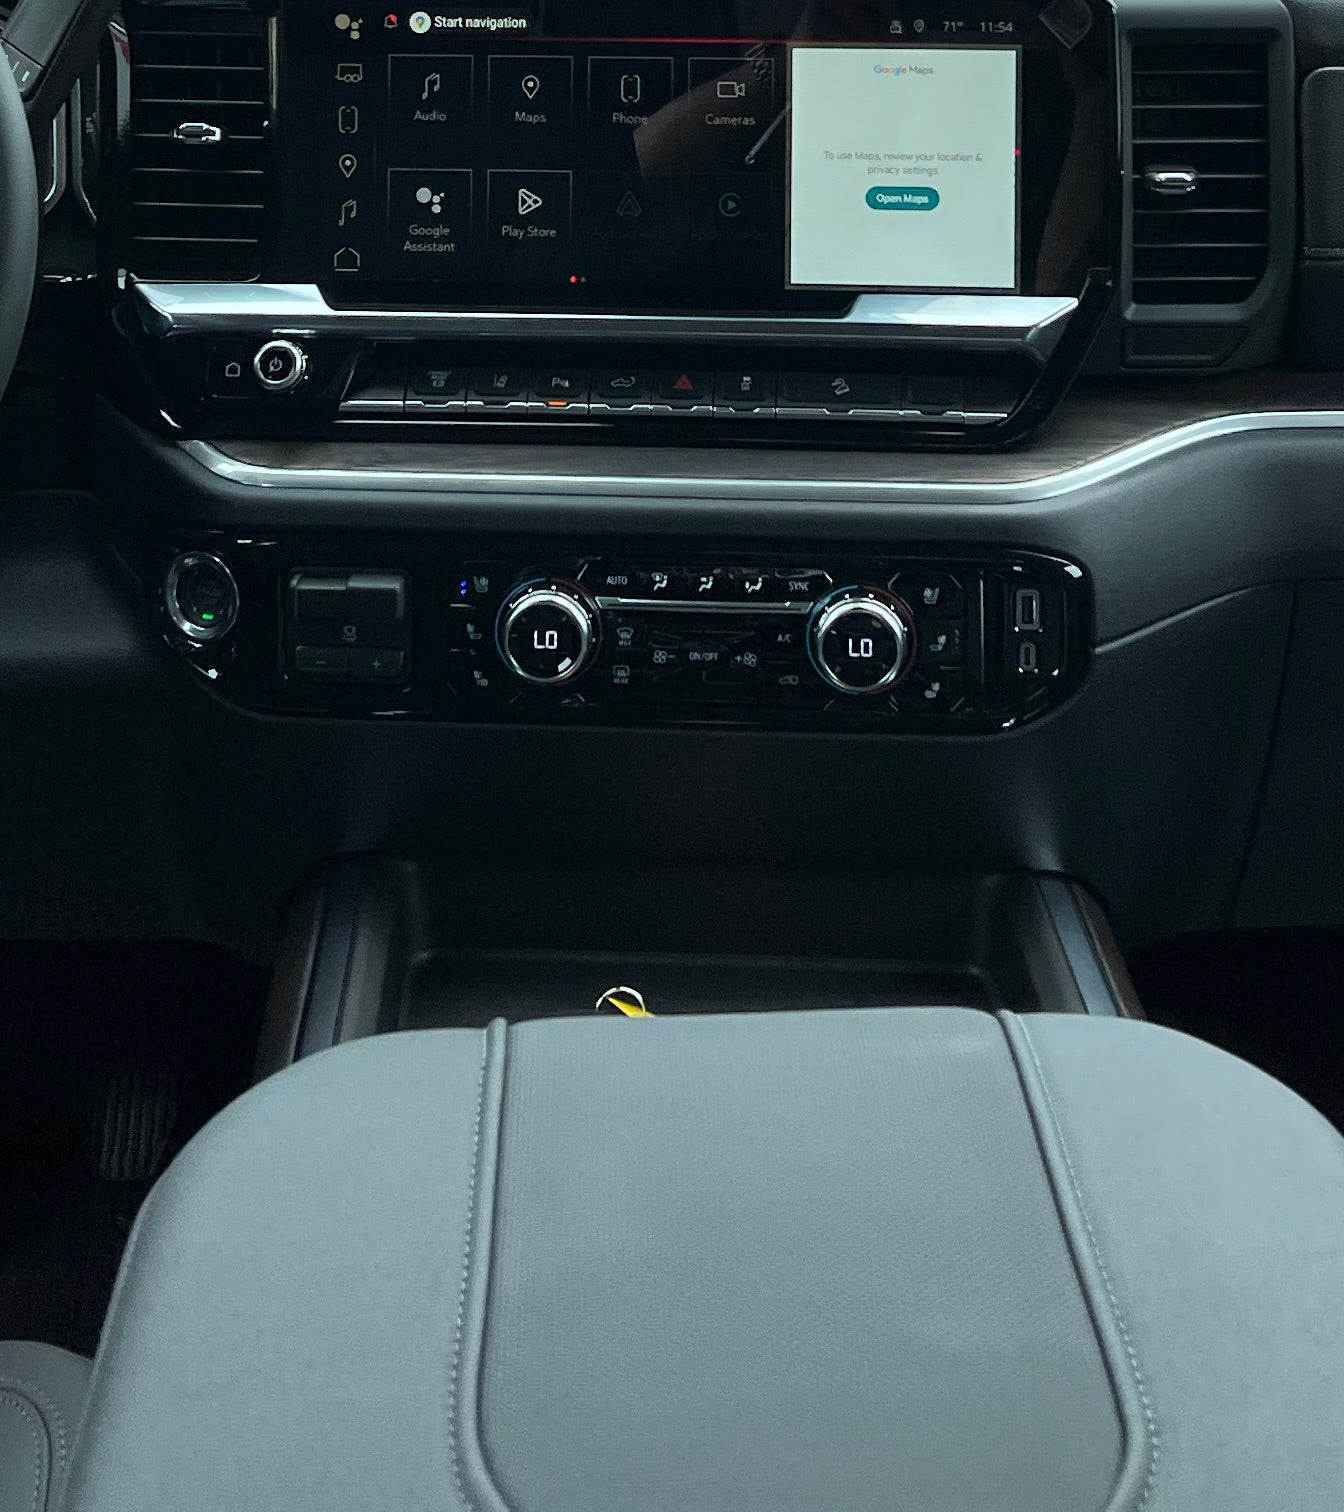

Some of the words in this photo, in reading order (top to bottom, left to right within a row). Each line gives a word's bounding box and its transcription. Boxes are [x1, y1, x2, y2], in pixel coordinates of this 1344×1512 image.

[434, 15, 463, 29] Start
[465, 15, 528, 32] navigation
[979, 21, 1014, 33] 11:54
[874, 64, 907, 76] Google
[909, 65, 934, 76] Maps
[413, 110, 447, 122] Audio
[514, 111, 547, 125] Maps
[611, 113, 648, 125] Phone
[704, 114, 756, 126] Cameras
[823, 151, 834, 160] To
[836, 152, 853, 160] use
[883, 152, 913, 161] review
[915, 153, 935, 163] your
[936, 152, 973, 161] location
[975, 153, 983, 161] &
[867, 165, 900, 176] privacy
[902, 166, 938, 176] settings
[875, 194, 902, 205] Open
[903, 194, 929, 205] Maps
[409, 224, 451, 238] Google
[501, 225, 525, 239] Play
[527, 226, 557, 238] Store
[403, 241, 456, 253] Assistant
[606, 575, 628, 586] AUTO
[787, 581, 810, 592] SYNC
[533, 630, 558, 650] LO
[777, 633, 792, 643] A/C
[848, 638, 873, 658] LO
[689, 652, 719, 662] ON/OFF
